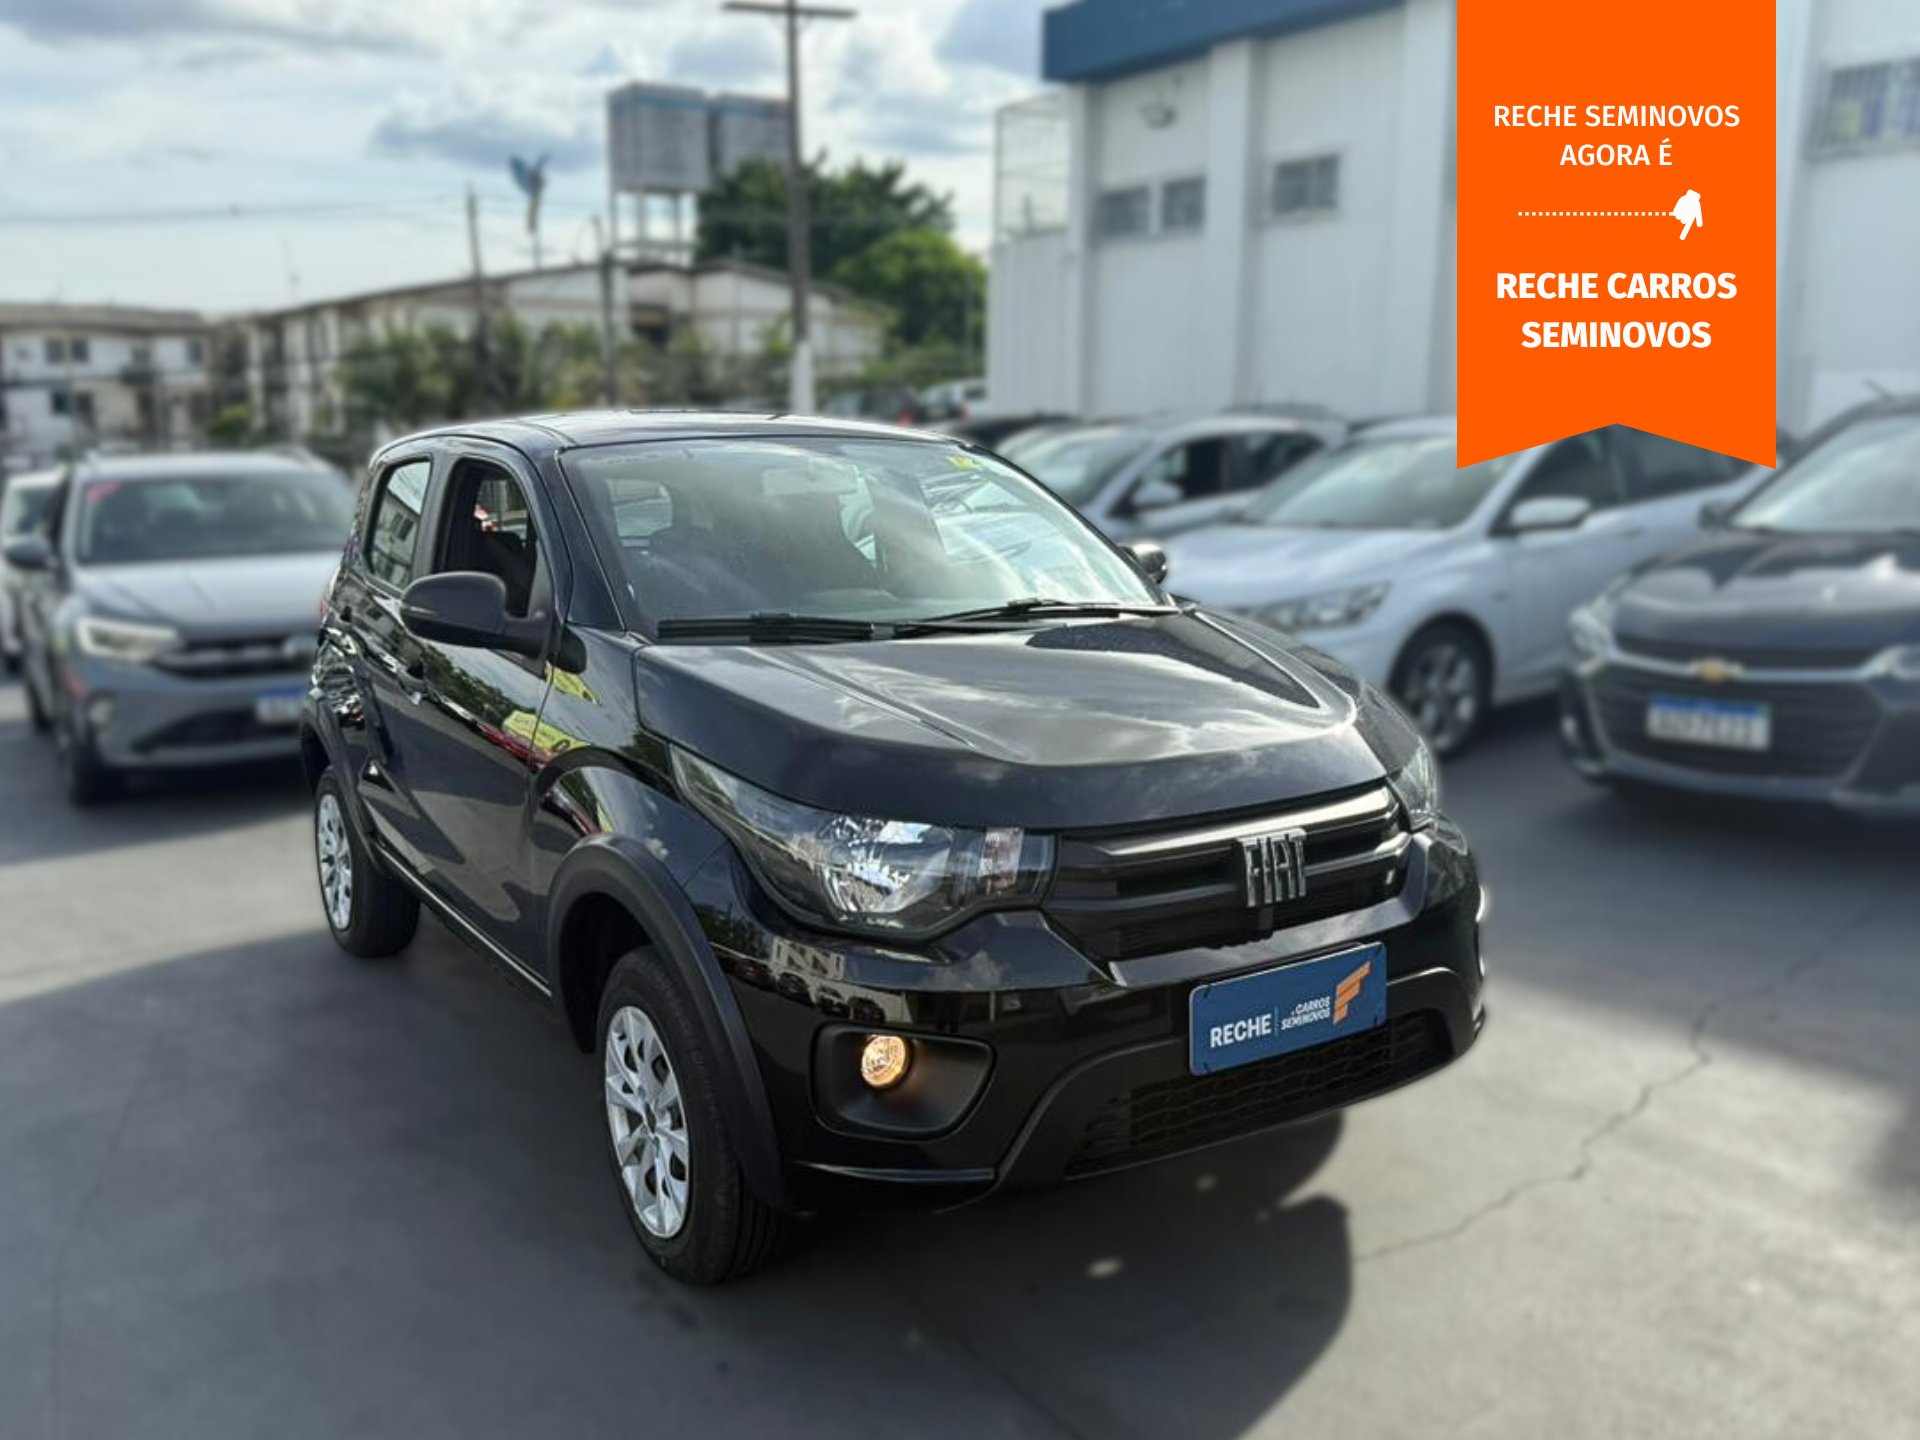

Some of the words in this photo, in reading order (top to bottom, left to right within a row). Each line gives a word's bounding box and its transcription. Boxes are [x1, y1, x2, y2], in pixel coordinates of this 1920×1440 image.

[1237, 828, 1307, 908] FIAT
[1280, 1007, 1331, 1030] SEMINOVOS
[1295, 996, 1331, 1017] CARROS
[1209, 1013, 1272, 1048] RECHE
